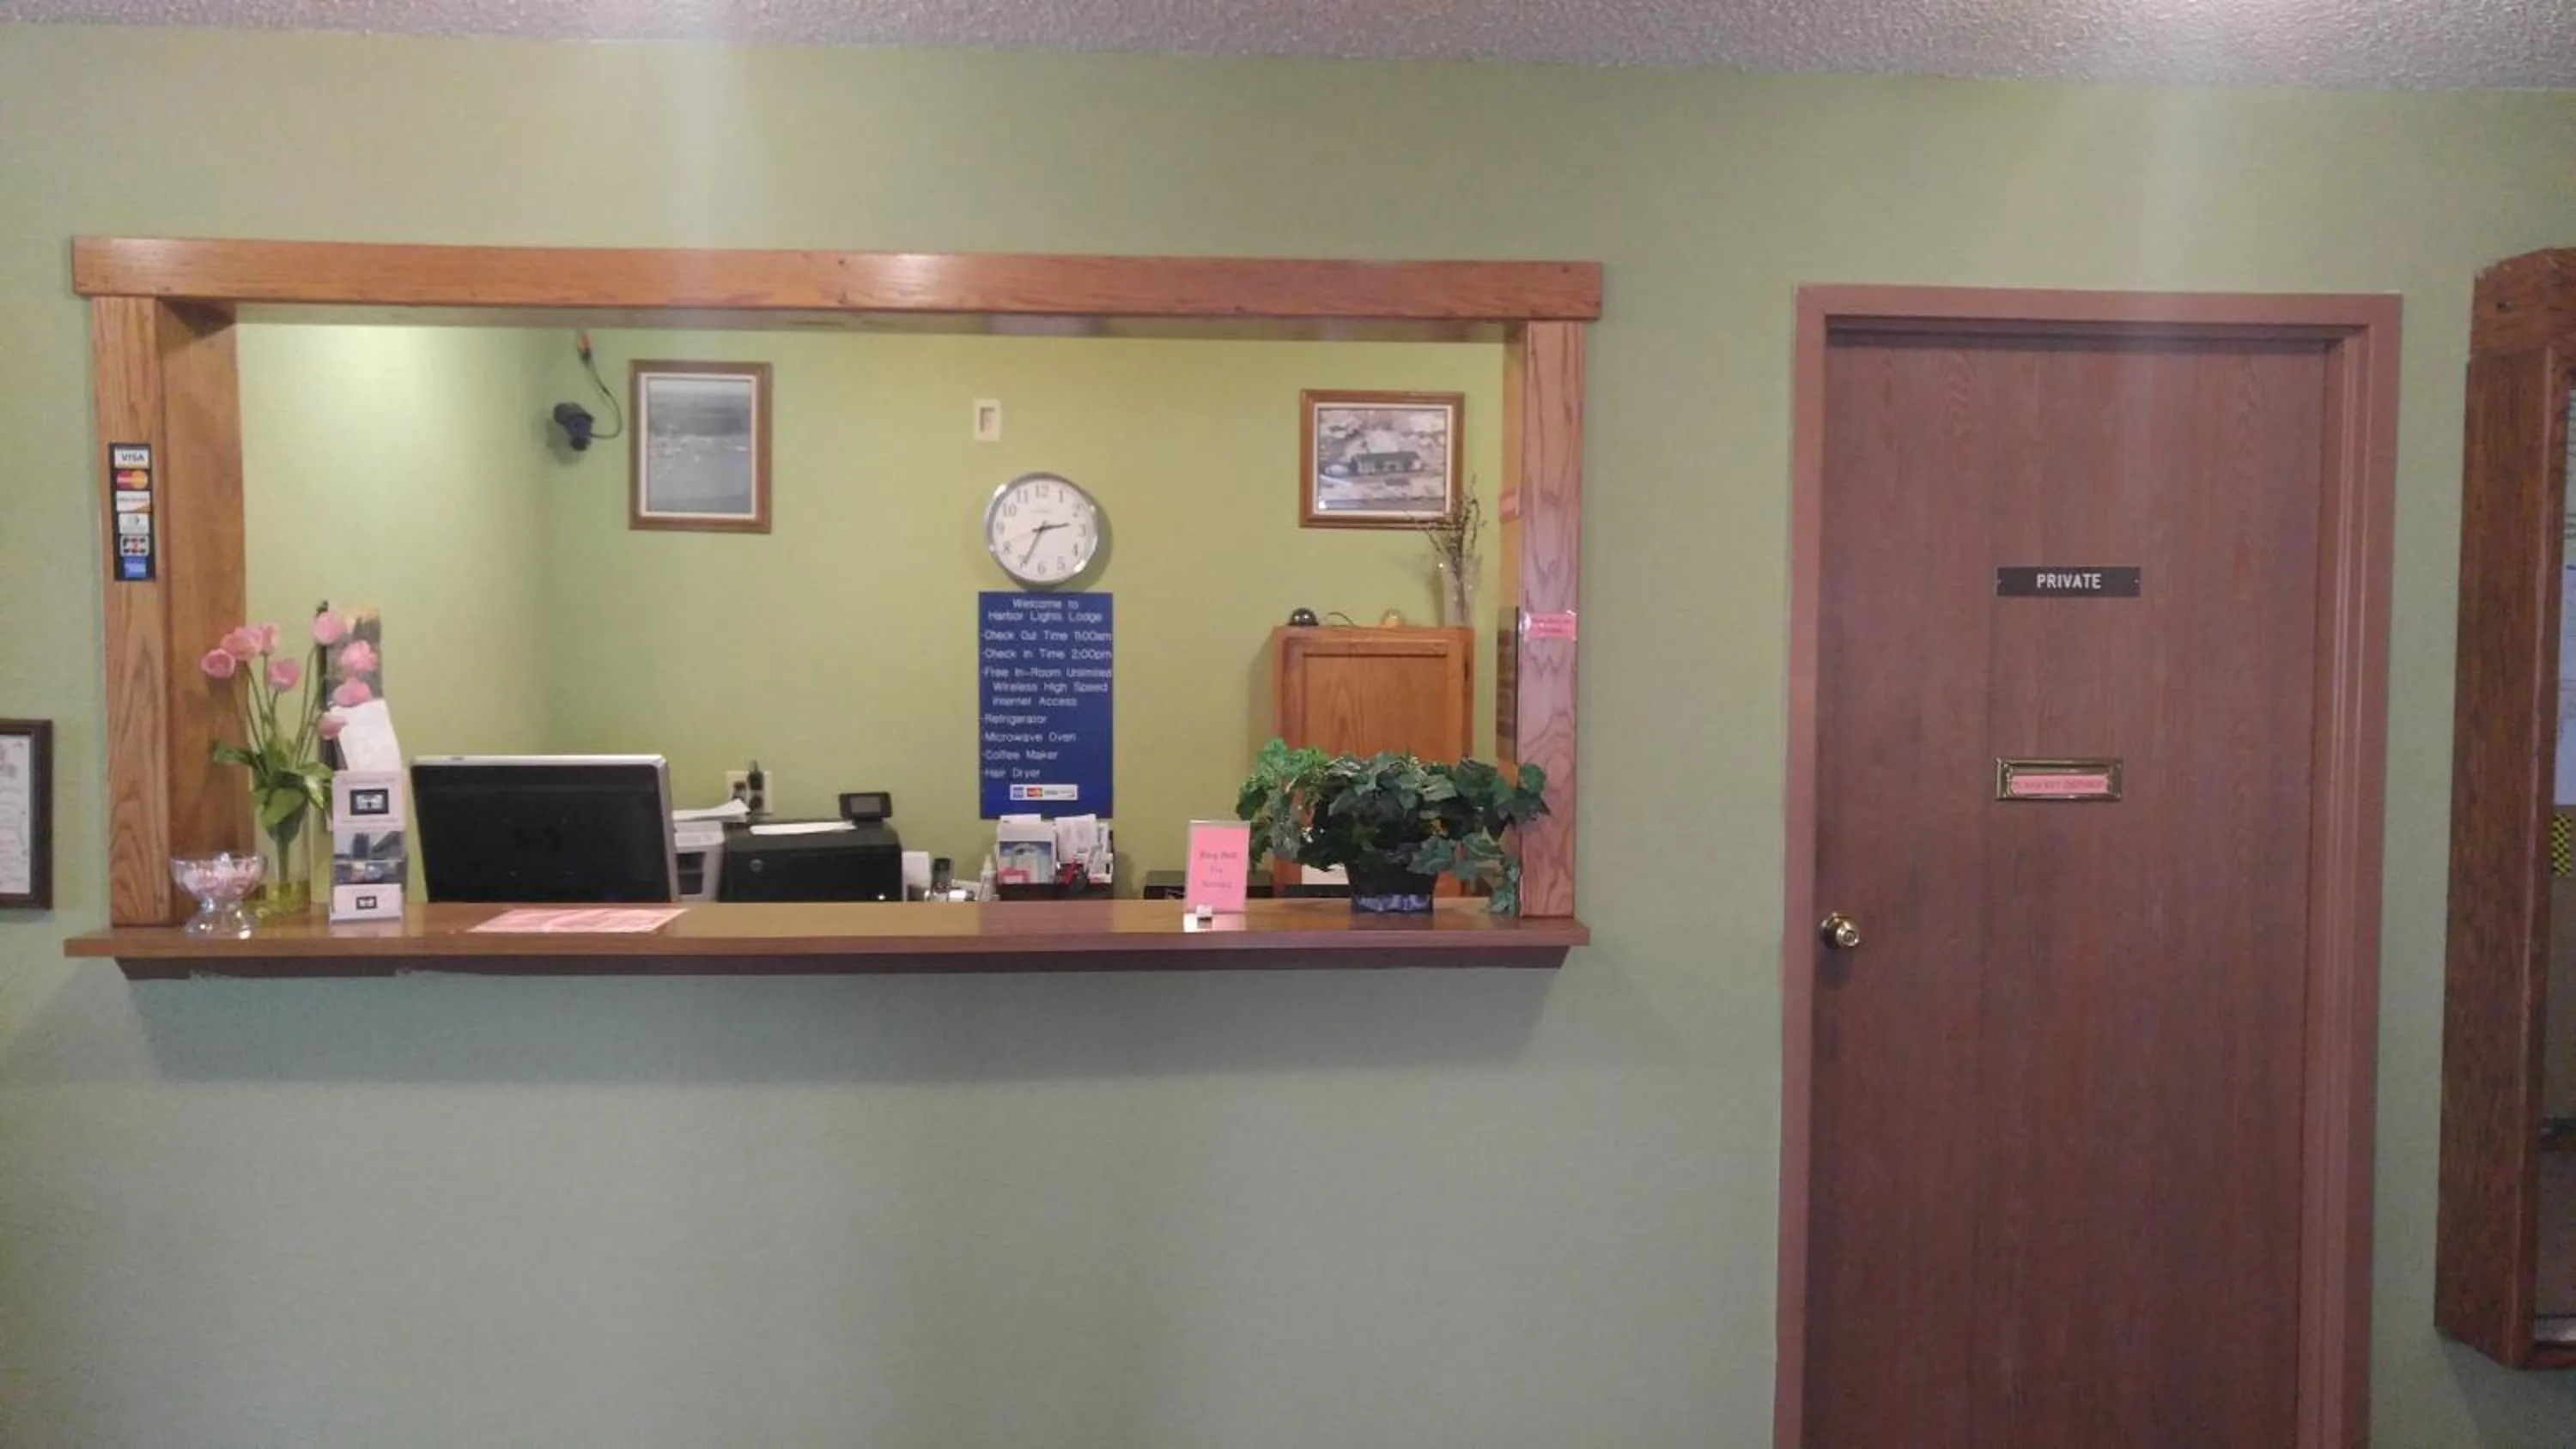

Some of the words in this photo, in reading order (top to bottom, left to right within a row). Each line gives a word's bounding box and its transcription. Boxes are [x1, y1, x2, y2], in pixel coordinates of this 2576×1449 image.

[121, 452, 145, 462] VISA
[2035, 573, 2102, 590] PRIVATE
[1012, 598, 1062, 609] Welcome
[1067, 599, 1079, 609] to
[988, 611, 1024, 621] Harbor
[1030, 611, 1063, 623] Lights
[1067, 612, 1103, 623] Lodge
[1020, 629, 1037, 641] Out
[1043, 629, 1068, 641] Time
[1039, 648, 1066, 659] Time
[993, 681, 1038, 692] Wireless
[1043, 682, 1067, 694] High
[1074, 681, 1109, 693] Speed
[992, 697, 1032, 706] Internet
[1038, 697, 1078, 706] Access
[1048, 731, 1077, 743] Oven
[1026, 749, 1059, 761] Maker
[1012, 767, 1042, 779] Dryer
